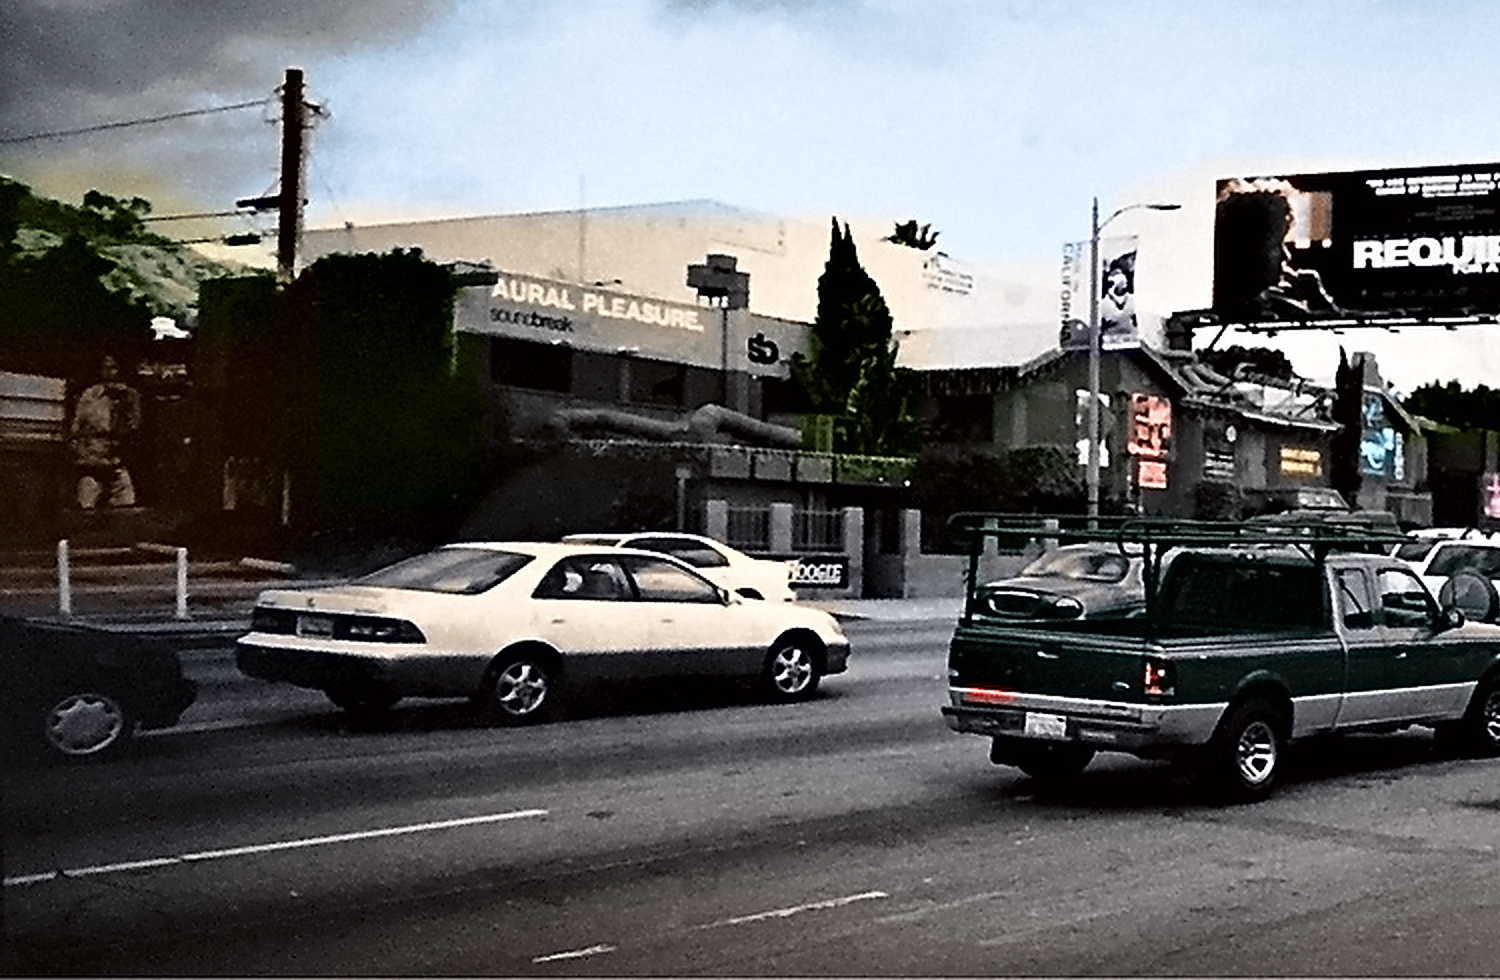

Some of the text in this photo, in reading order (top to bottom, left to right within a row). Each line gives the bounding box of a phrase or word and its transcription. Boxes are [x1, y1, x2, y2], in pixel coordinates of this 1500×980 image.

[490, 307, 574, 332] soundbreak
[491, 278, 704, 332] AURAL PLEASURE.
